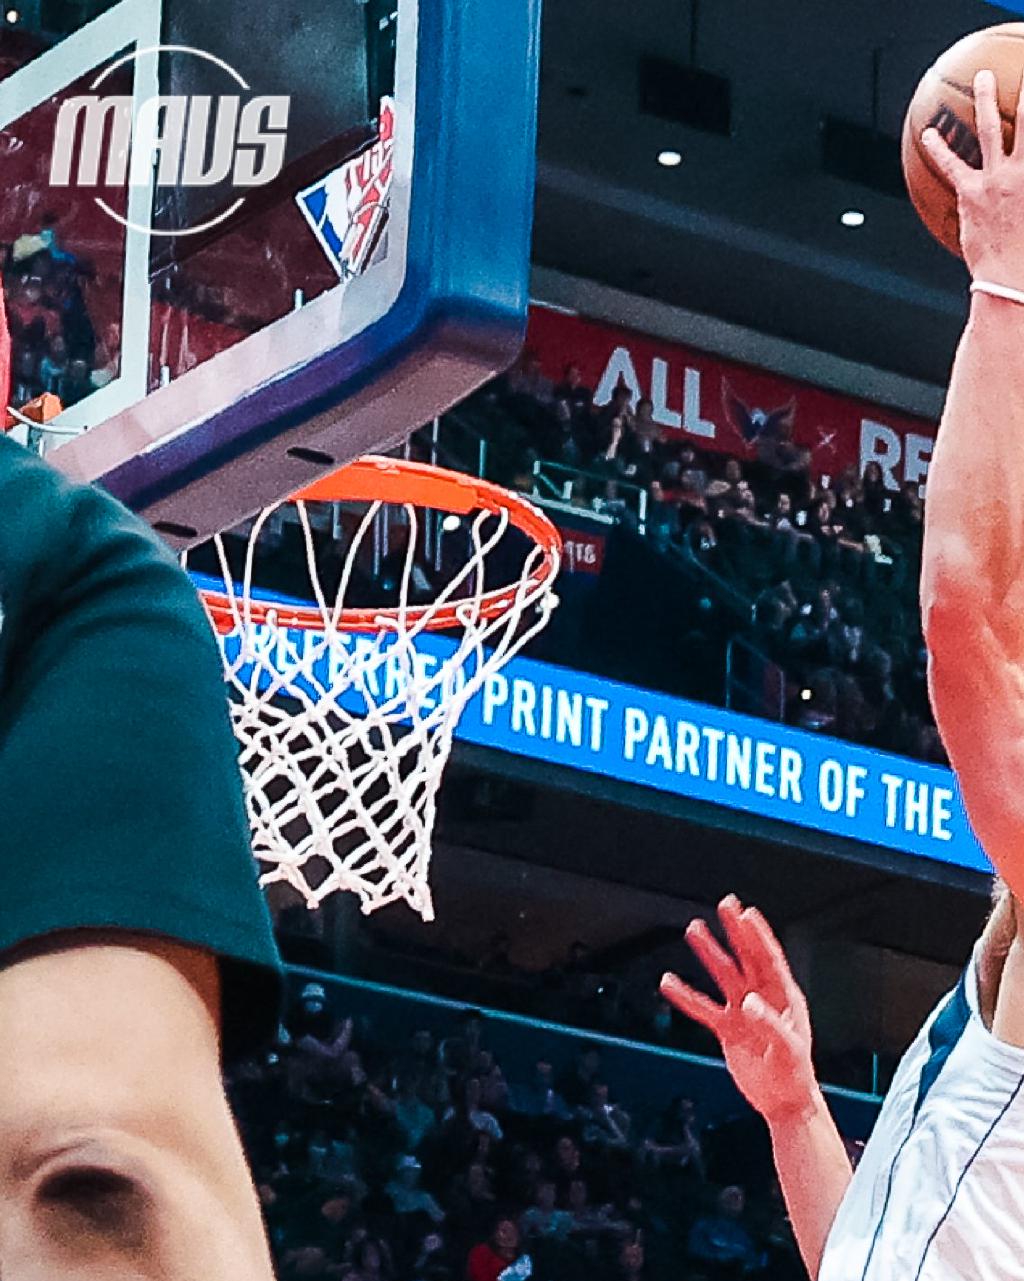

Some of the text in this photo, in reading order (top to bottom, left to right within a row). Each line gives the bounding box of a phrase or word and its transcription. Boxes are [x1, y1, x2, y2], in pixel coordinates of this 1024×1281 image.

[593, 346, 716, 438] ALL
[483, 672, 609, 753] PRINT
[622, 706, 802, 804] PARTNER
[818, 758, 867, 818] OF
[881, 772, 953, 841] THE
